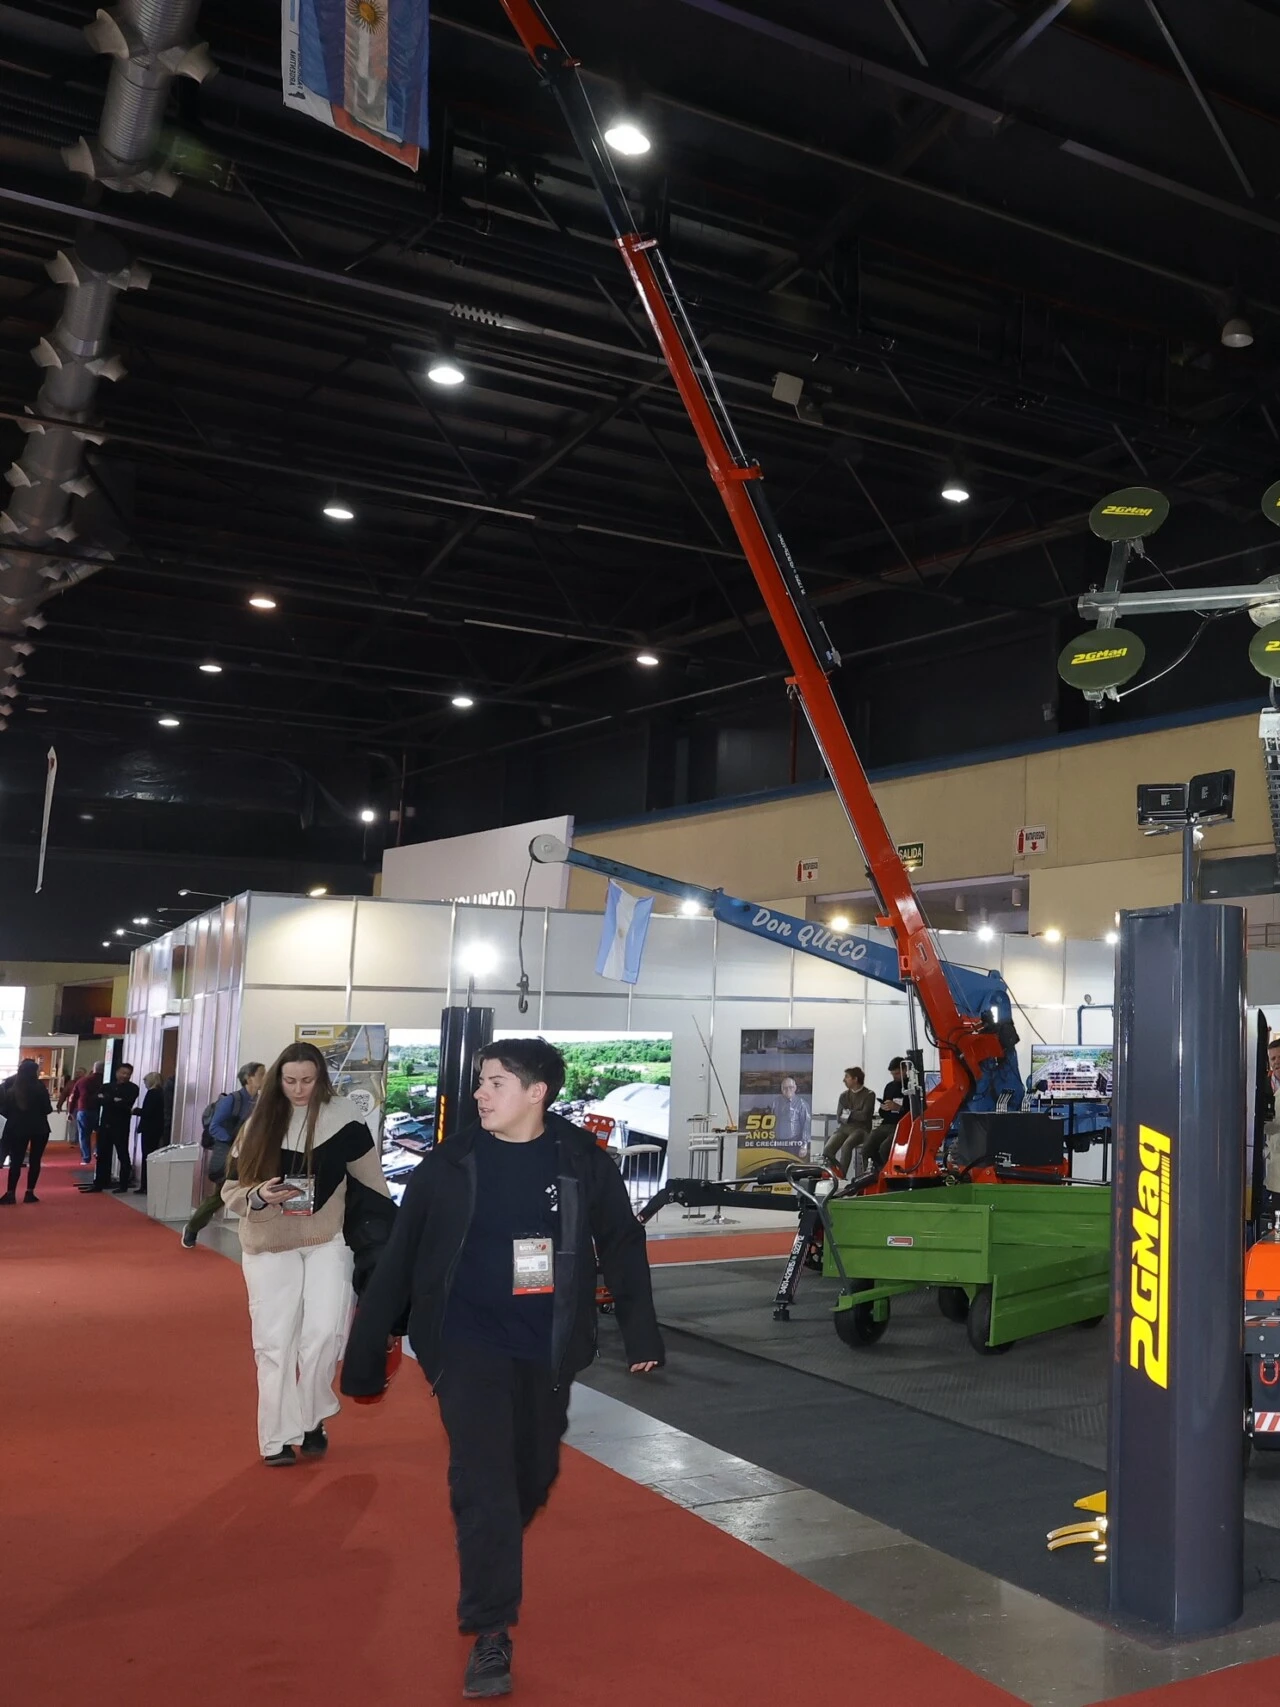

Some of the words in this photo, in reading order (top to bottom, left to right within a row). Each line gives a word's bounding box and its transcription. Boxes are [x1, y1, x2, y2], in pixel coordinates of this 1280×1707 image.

[1101, 505, 1153, 517] 2GMaq
[1071, 647, 1128, 665] 2GMaq
[899, 847, 923, 860] SALIDA
[752, 908, 792, 936] Don
[797, 925, 867, 961] QUECO
[745, 1115, 776, 1130] 50
[745, 1130, 776, 1140] AÑOS
[1130, 1124, 1171, 1390] 2GMaq
